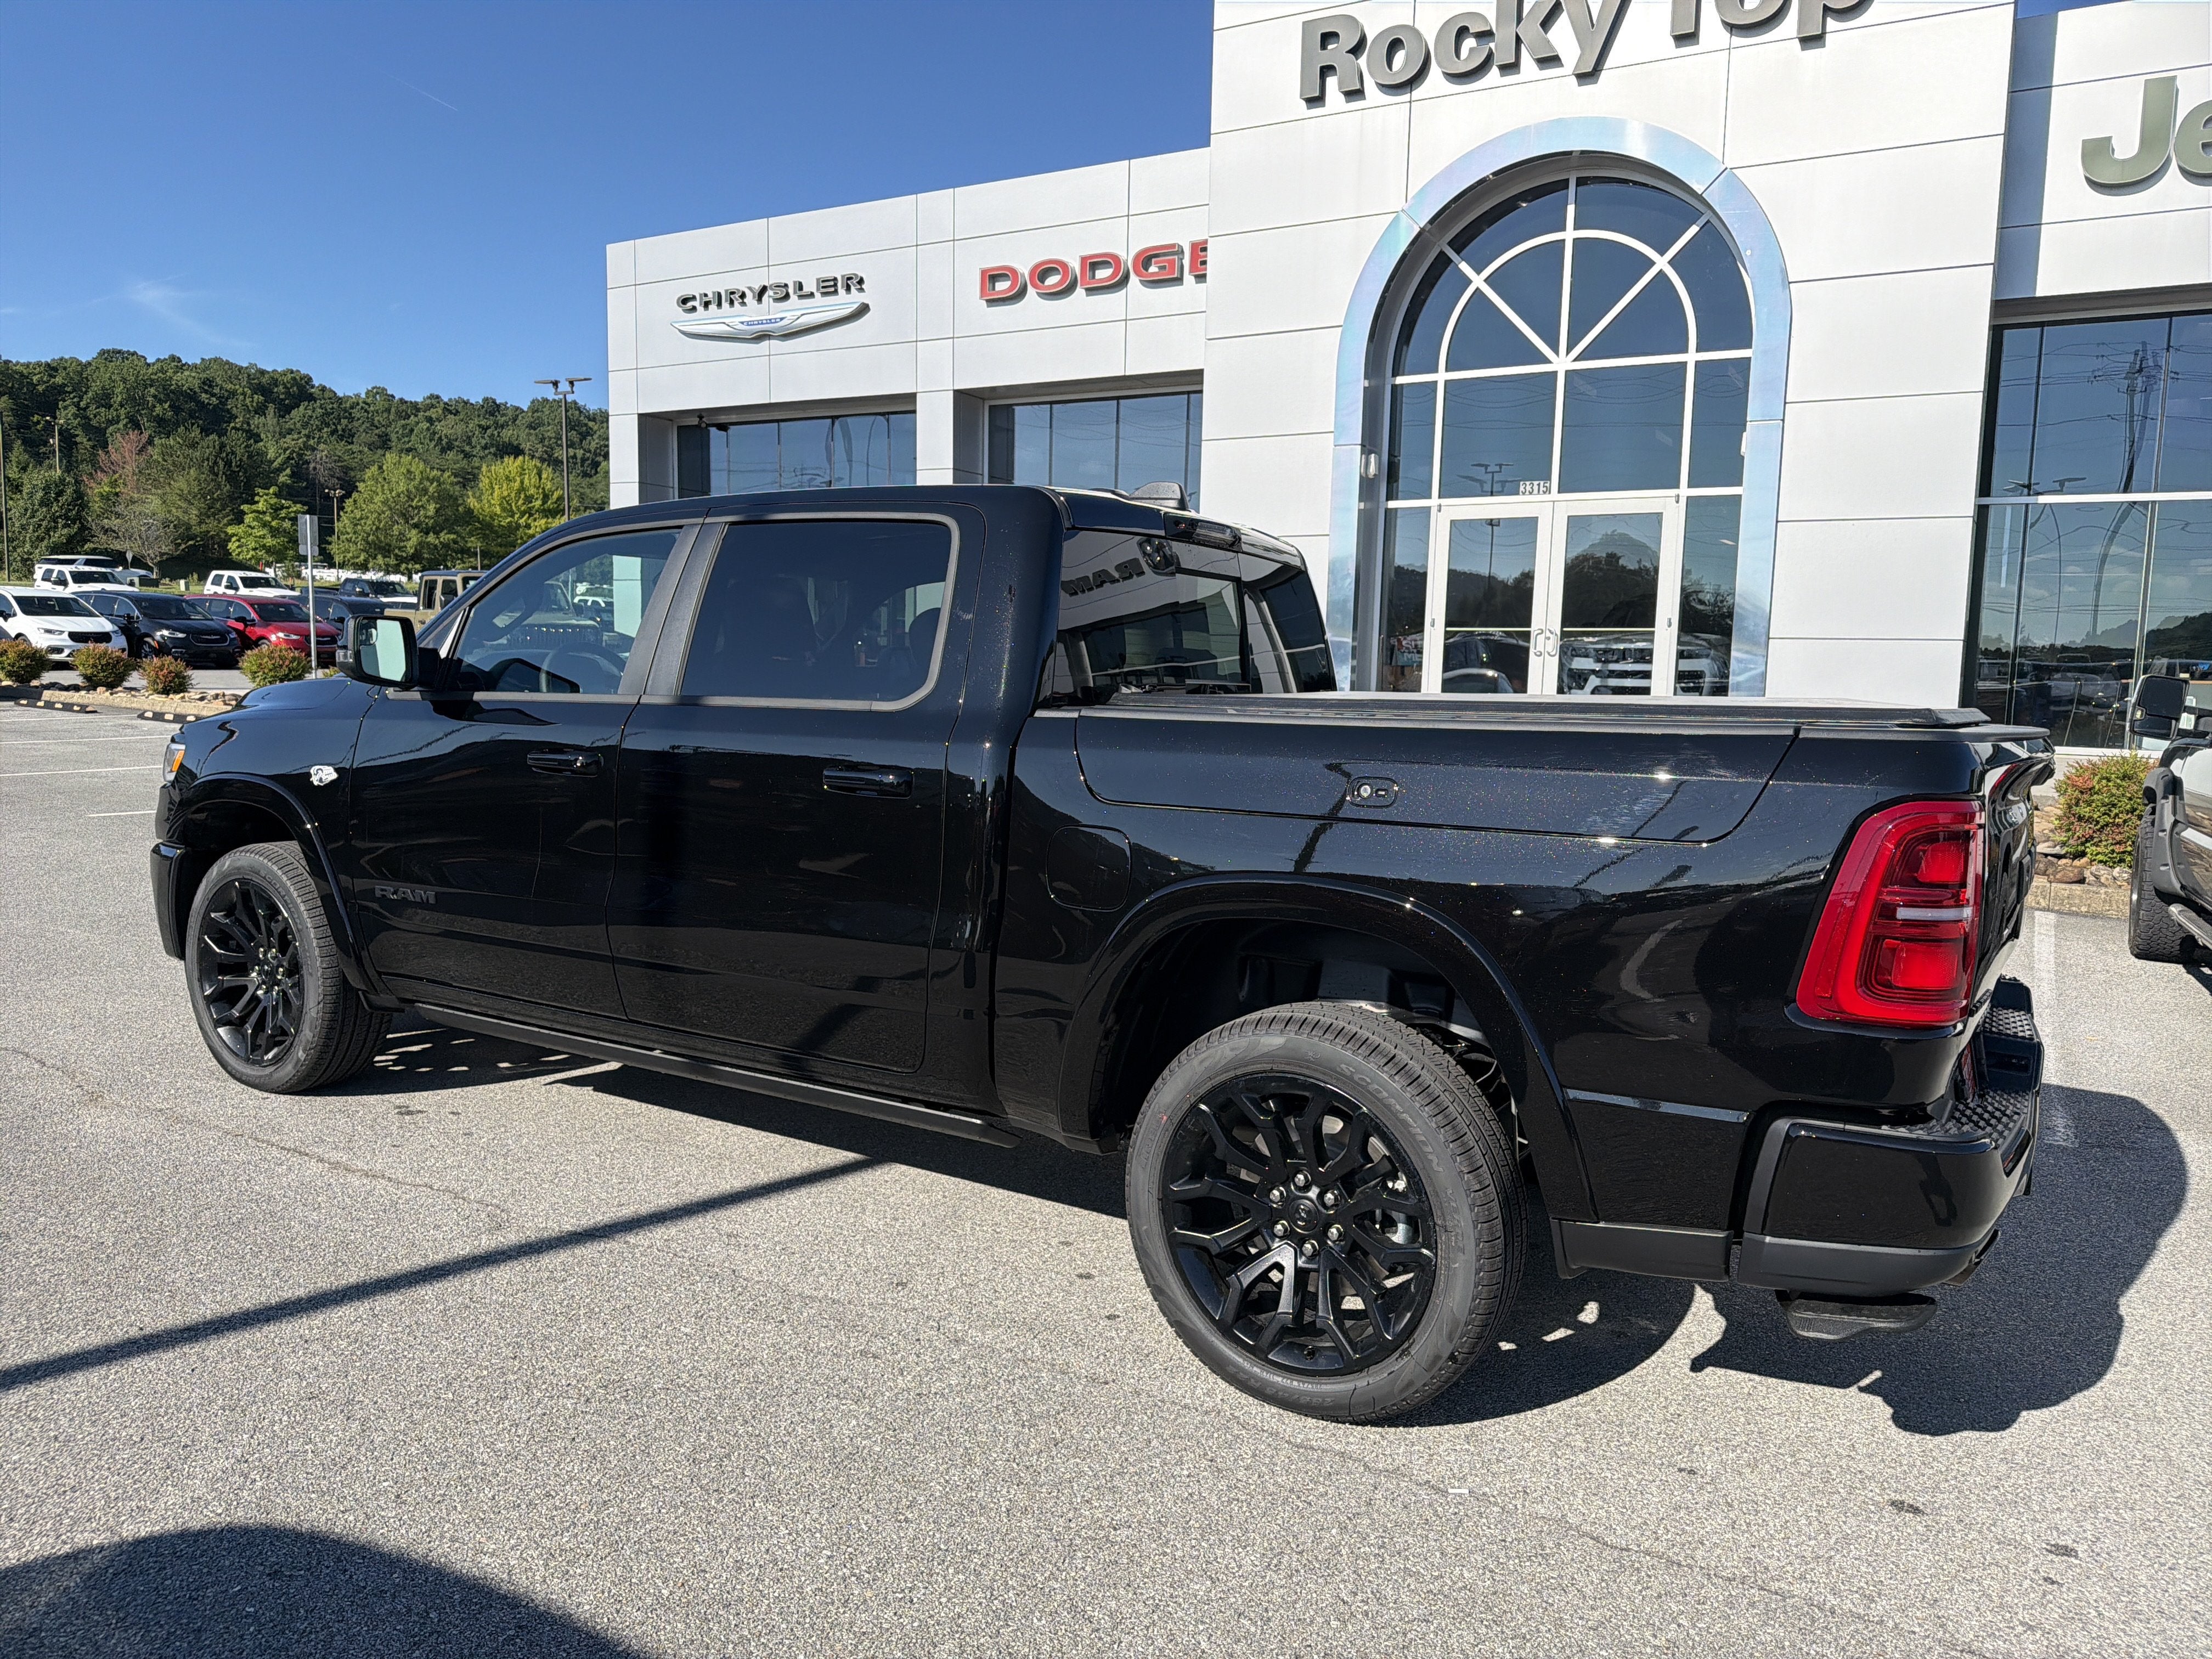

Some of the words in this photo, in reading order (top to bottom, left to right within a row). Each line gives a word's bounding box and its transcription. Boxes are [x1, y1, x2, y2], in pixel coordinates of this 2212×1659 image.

[1299, 0, 1625, 100] Rocky
[676, 272, 865, 312] CHRYSLER
[1521, 482, 1549, 494] 3315
[375, 885, 436, 904] RAM
[1336, 1063, 1445, 1173] SCORPION
